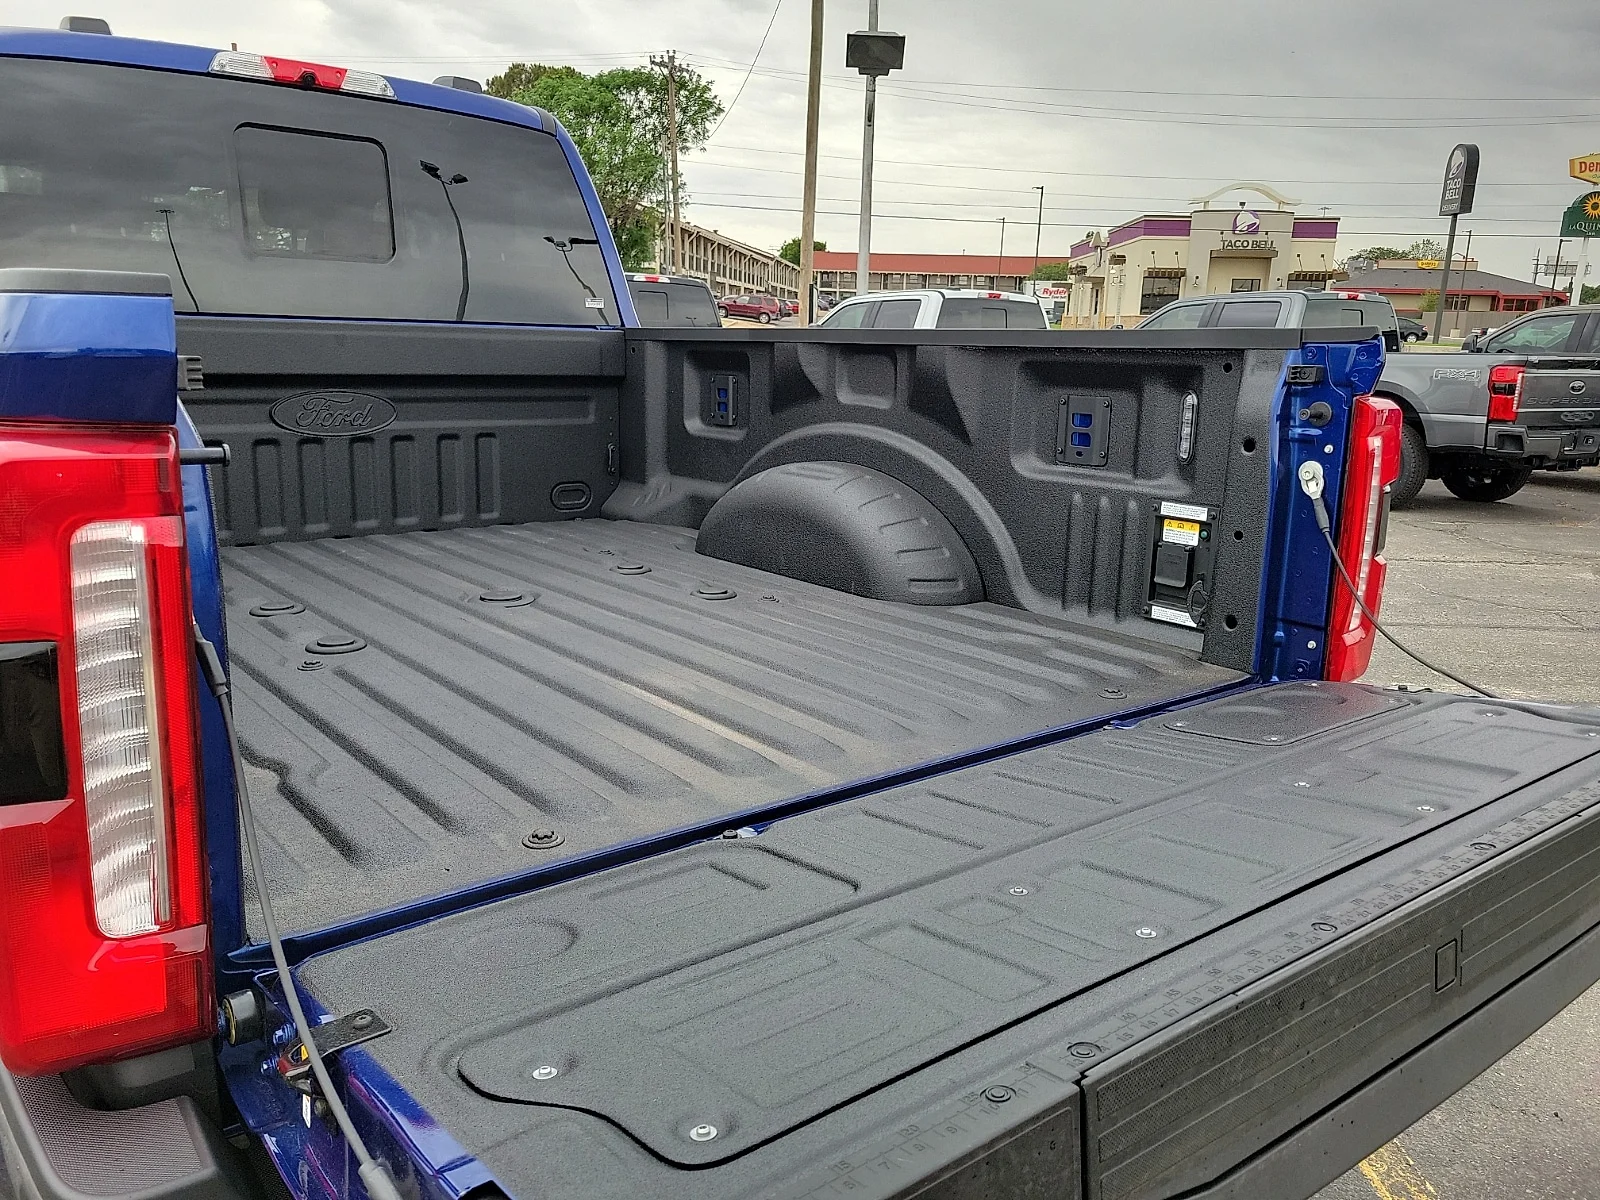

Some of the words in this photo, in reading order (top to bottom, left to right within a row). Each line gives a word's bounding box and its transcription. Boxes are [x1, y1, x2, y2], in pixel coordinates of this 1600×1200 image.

[1446, 178, 1461, 190] TACO
[1444, 188, 1460, 201] BELL
[1220, 239, 1250, 250] TACO
[1250, 239, 1277, 250] BELL
[1042, 287, 1068, 296] Ryder
[1433, 368, 1481, 381] FX4
[1526, 396, 1580, 405] SUPER
[295, 396, 374, 429] Ford
